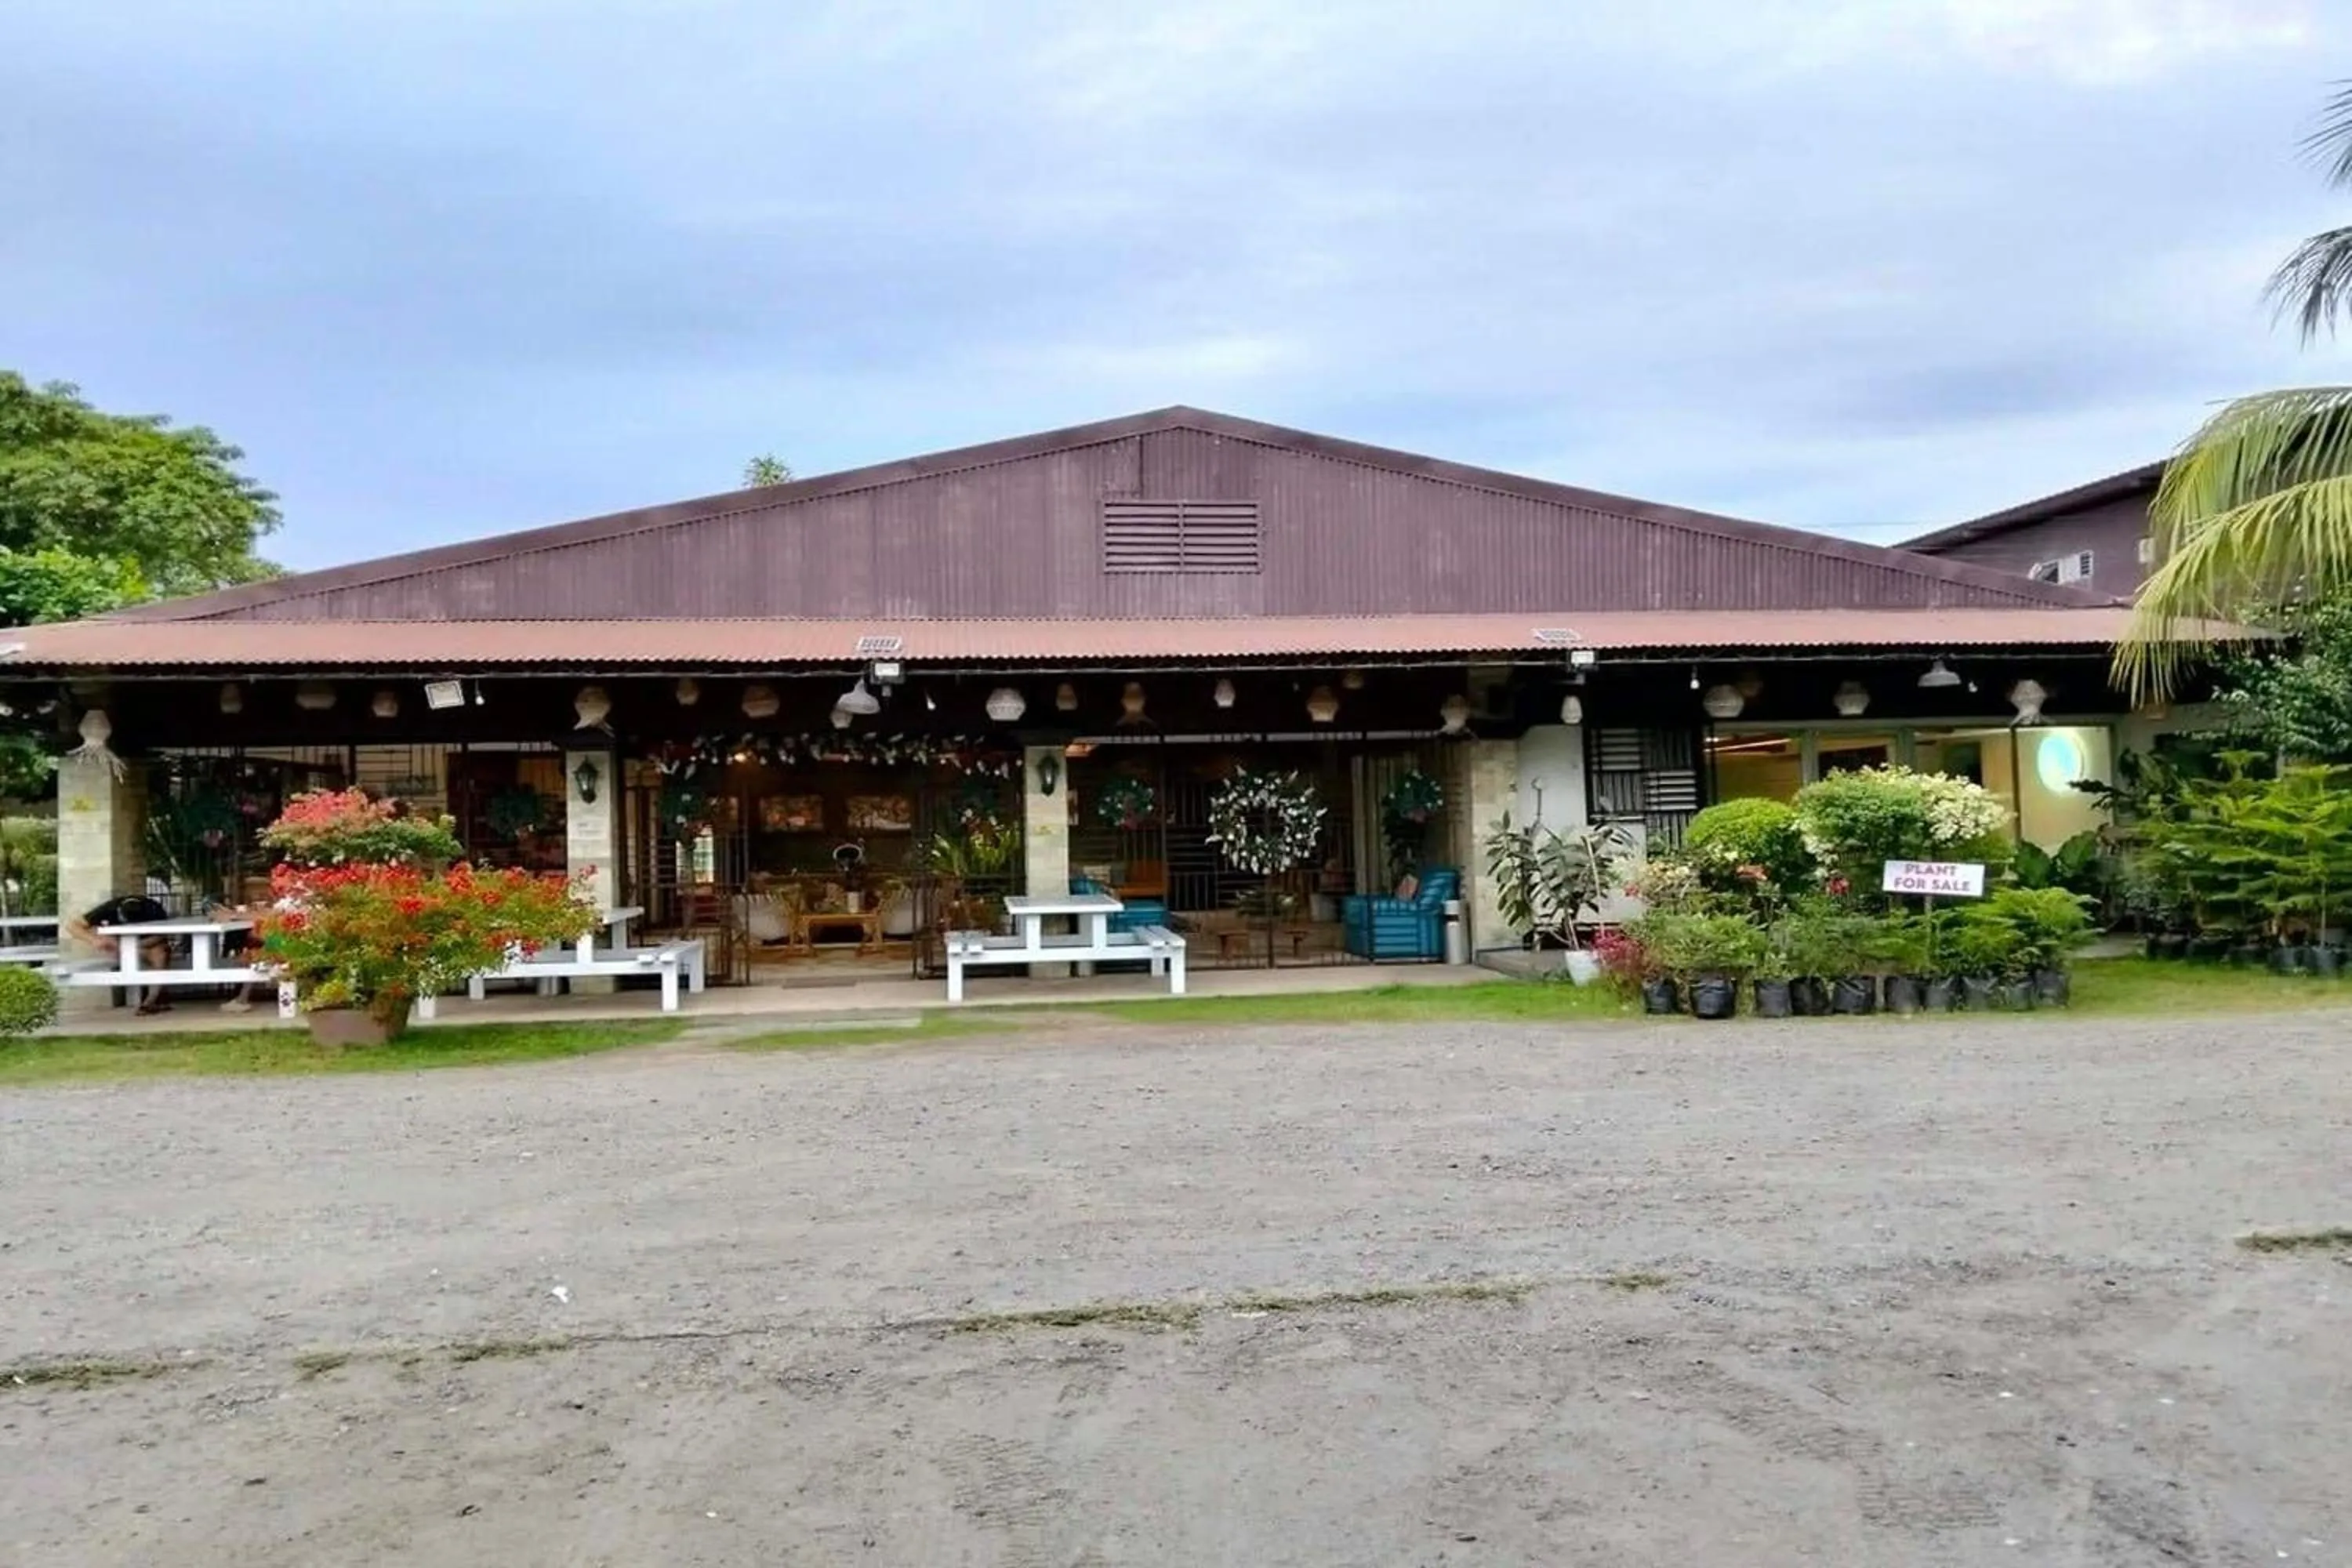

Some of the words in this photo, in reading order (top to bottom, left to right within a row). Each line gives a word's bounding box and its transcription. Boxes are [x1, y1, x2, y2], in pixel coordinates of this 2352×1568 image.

[1905, 863, 1956, 876] PLANT
[1894, 877, 1926, 889] FOR
[1931, 879, 1970, 891] SALE
